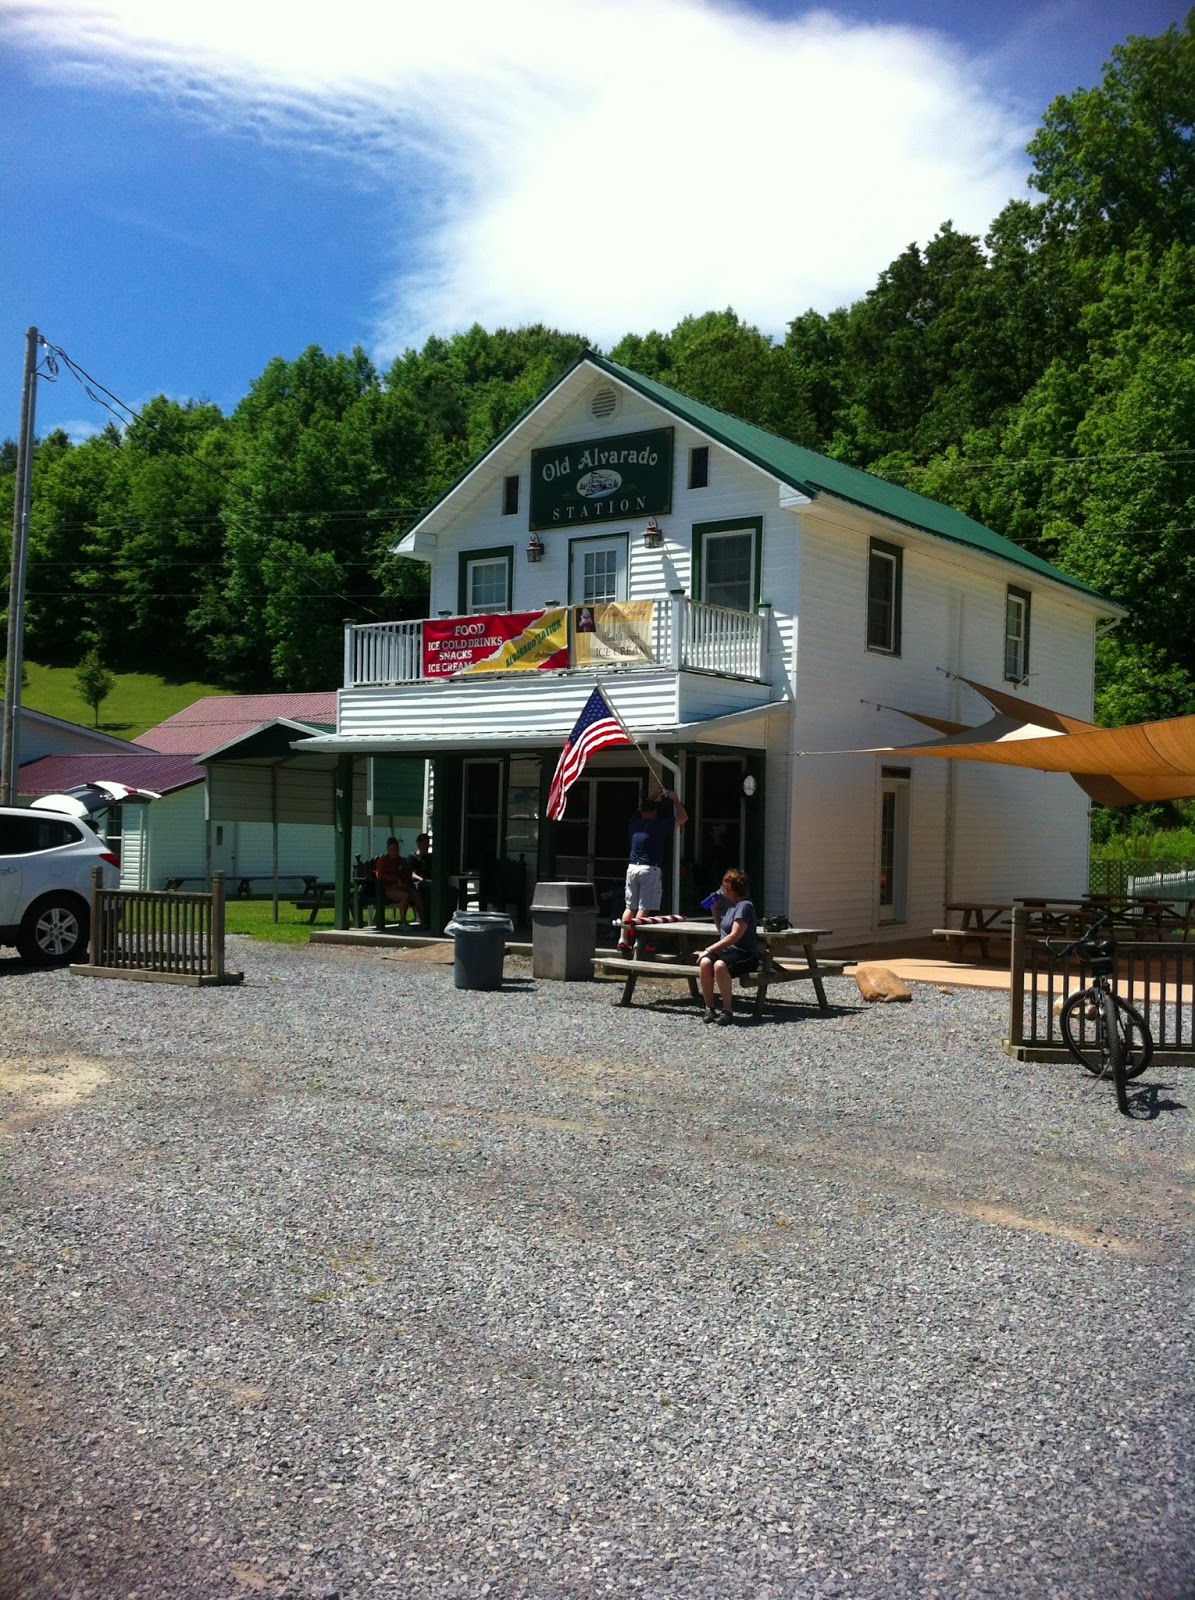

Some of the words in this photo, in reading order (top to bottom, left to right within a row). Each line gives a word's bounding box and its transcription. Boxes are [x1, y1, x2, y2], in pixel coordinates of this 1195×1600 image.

[542, 457, 570, 482] Old
[577, 446, 658, 470] Alvarado
[552, 496, 646, 521] STATION
[454, 623, 485, 637] FOOD
[428, 641, 440, 651] ICE
[442, 639, 468, 650] COLD
[468, 636, 503, 647] DRINKS
[439, 649, 473, 661] SNACKS
[595, 647, 611, 657] ICE
[614, 645, 648, 656] CREAM
[428, 663, 440, 673] ICE
